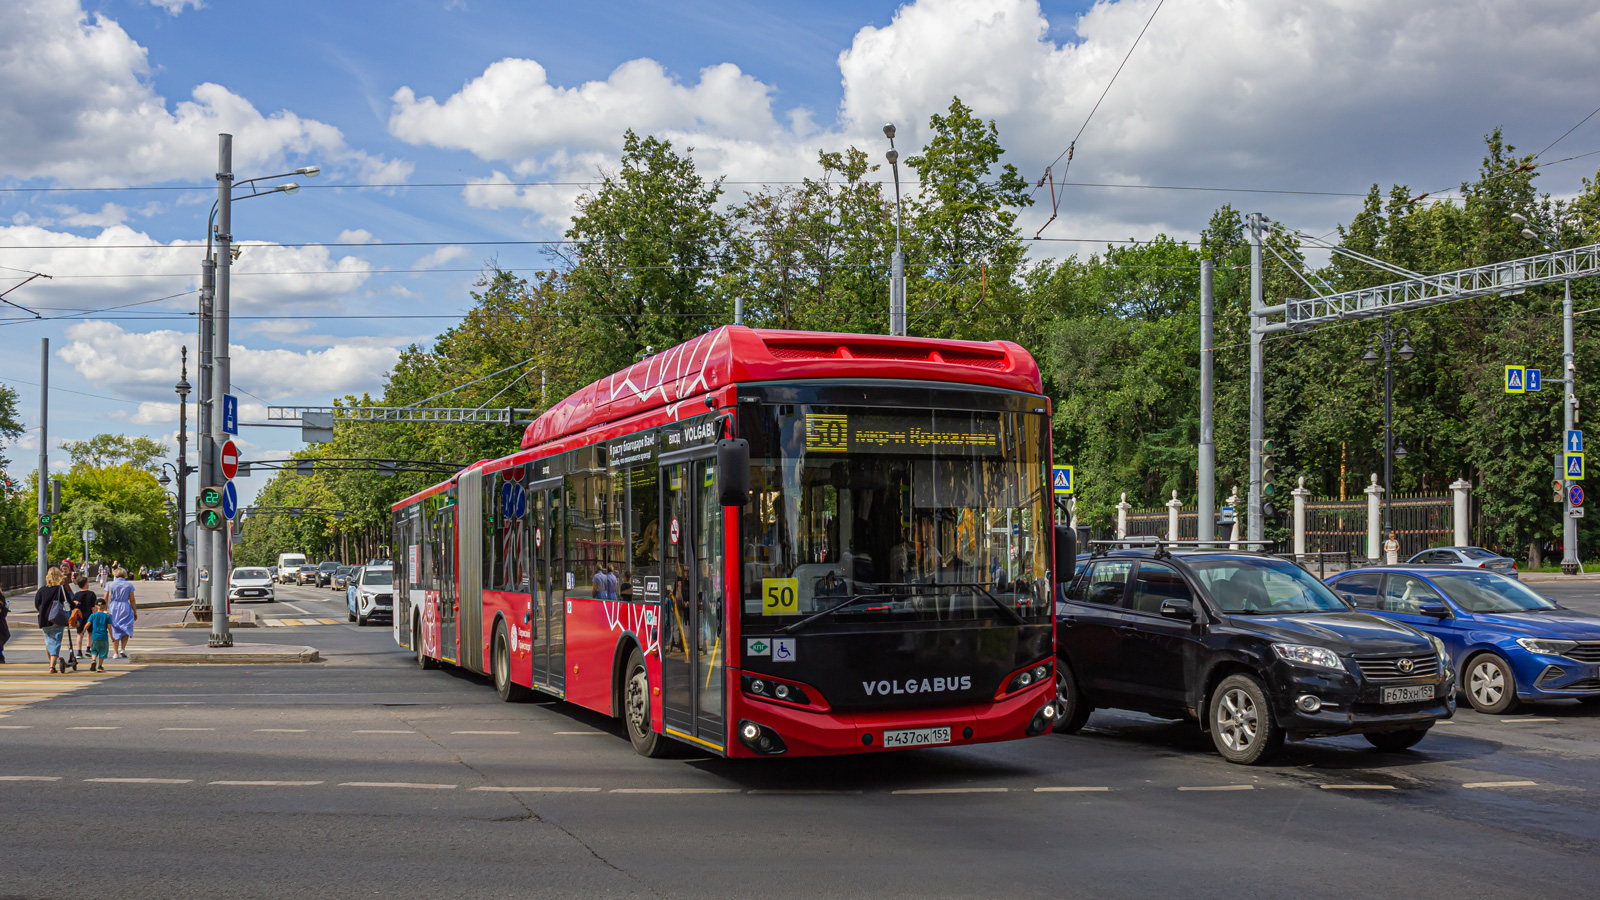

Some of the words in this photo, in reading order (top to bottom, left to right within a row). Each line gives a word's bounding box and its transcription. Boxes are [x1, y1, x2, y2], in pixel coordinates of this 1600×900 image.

[685, 422, 715, 441] VOLGABU
[808, 418, 846, 447] 50
[205, 491, 219, 503] 22
[767, 586, 794, 608] 50
[862, 676, 971, 695] VOLGABUS
